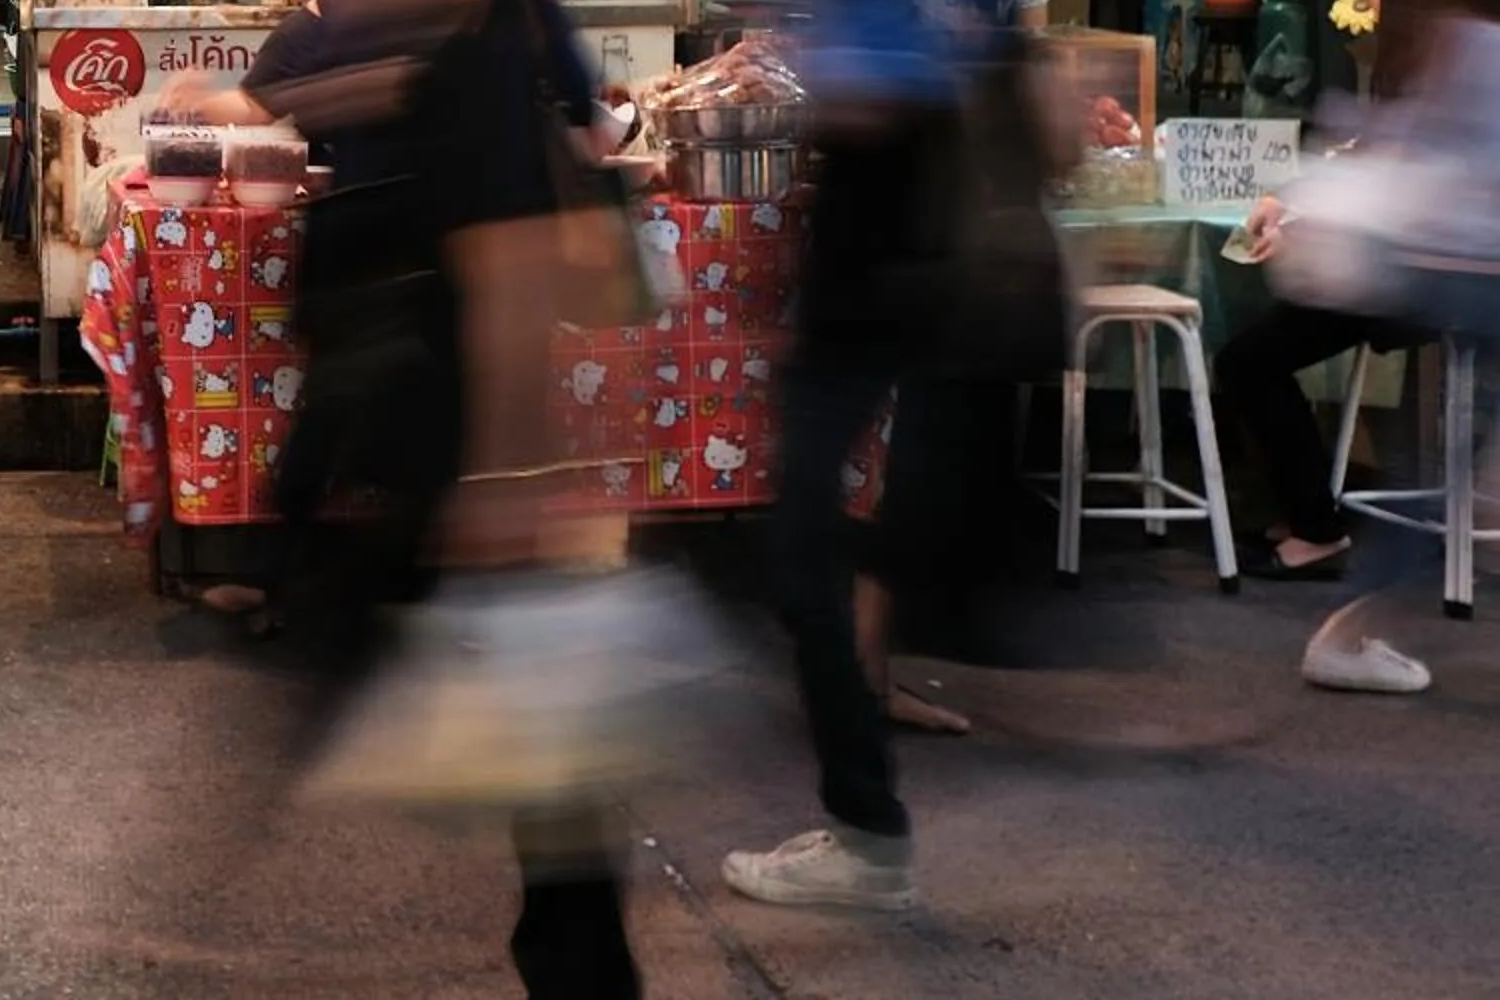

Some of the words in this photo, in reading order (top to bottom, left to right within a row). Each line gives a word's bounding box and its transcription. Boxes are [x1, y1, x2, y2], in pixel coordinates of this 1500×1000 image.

[159, 36, 257, 71] สั่งโค้ก
[1261, 140, 1292, 162] 40
